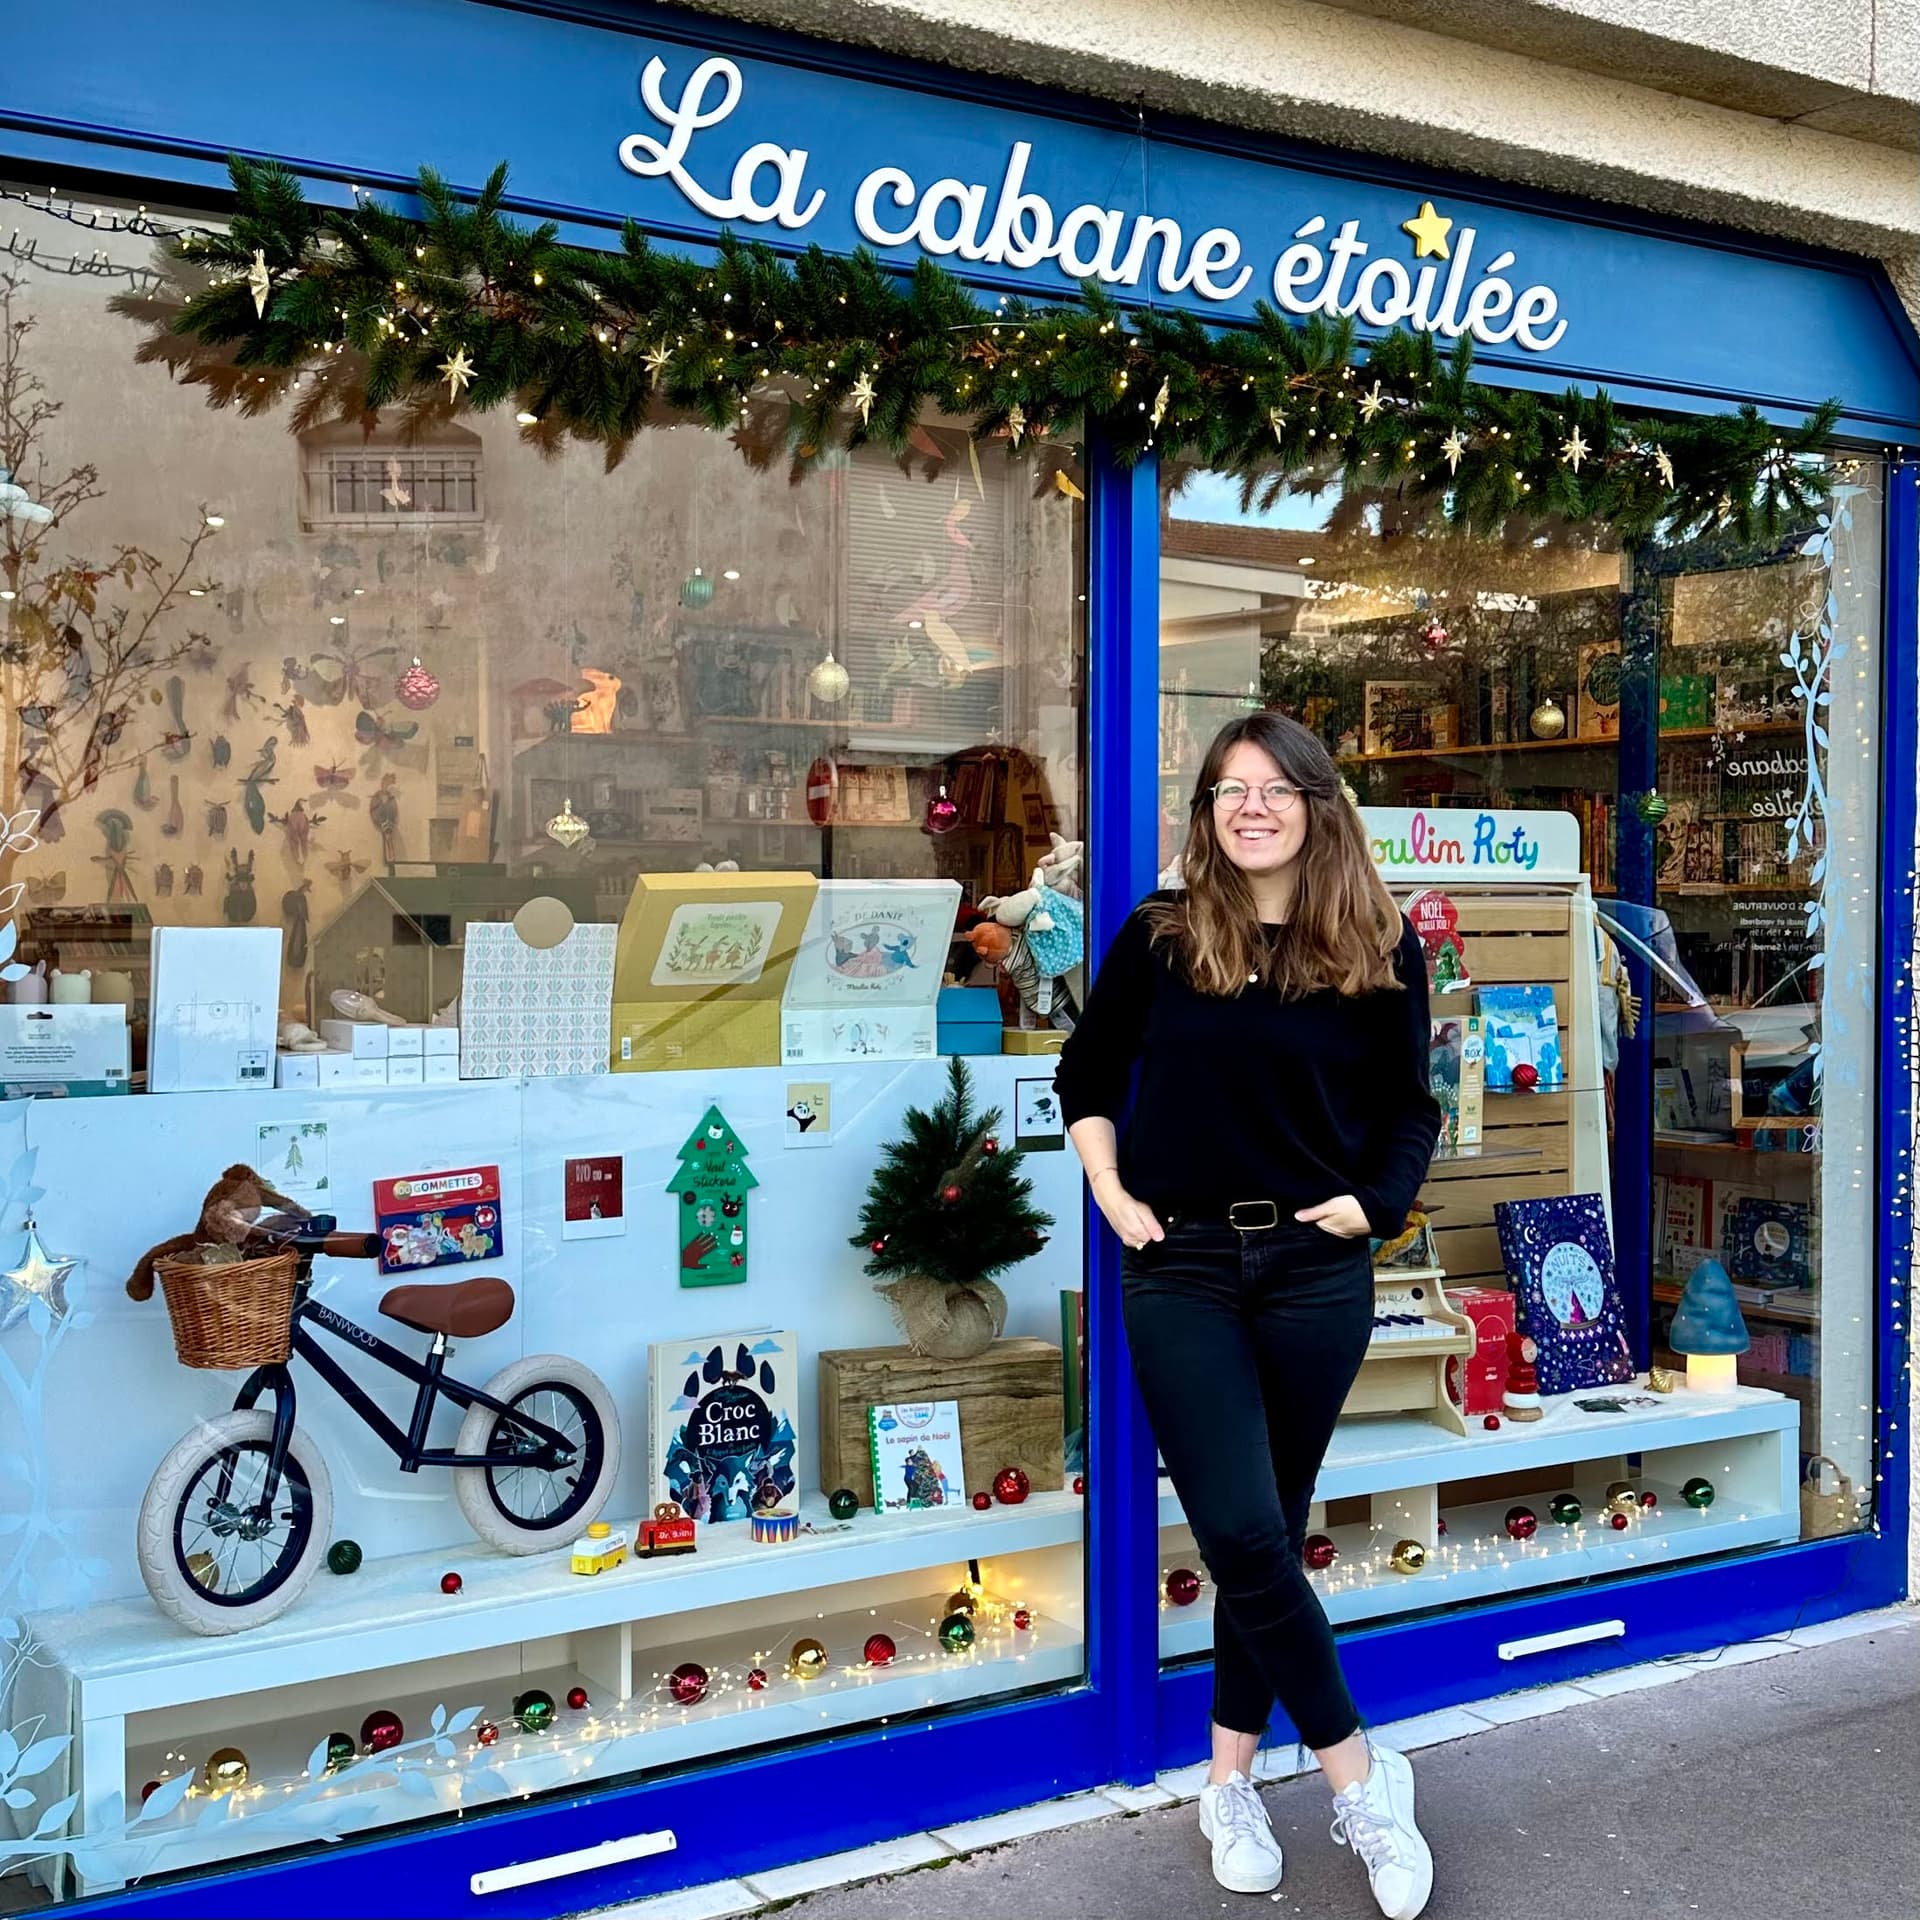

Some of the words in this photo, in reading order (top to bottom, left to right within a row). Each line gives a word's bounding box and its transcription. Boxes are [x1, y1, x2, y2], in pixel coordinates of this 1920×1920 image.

[619, 55, 826, 229] La
[855, 142, 1252, 302] cabane
[1273, 205, 1568, 352] étoilée
[1370, 812, 1465, 865] oulin
[1473, 812, 1539, 870] Roty
[413, 1175, 481, 1193] GOMMETTES
[1551, 1253, 1586, 1272] NUITS
[318, 1306, 378, 1348] BANWOOD
[705, 1401, 756, 1423] Croc
[699, 1423, 760, 1446] Blanc
